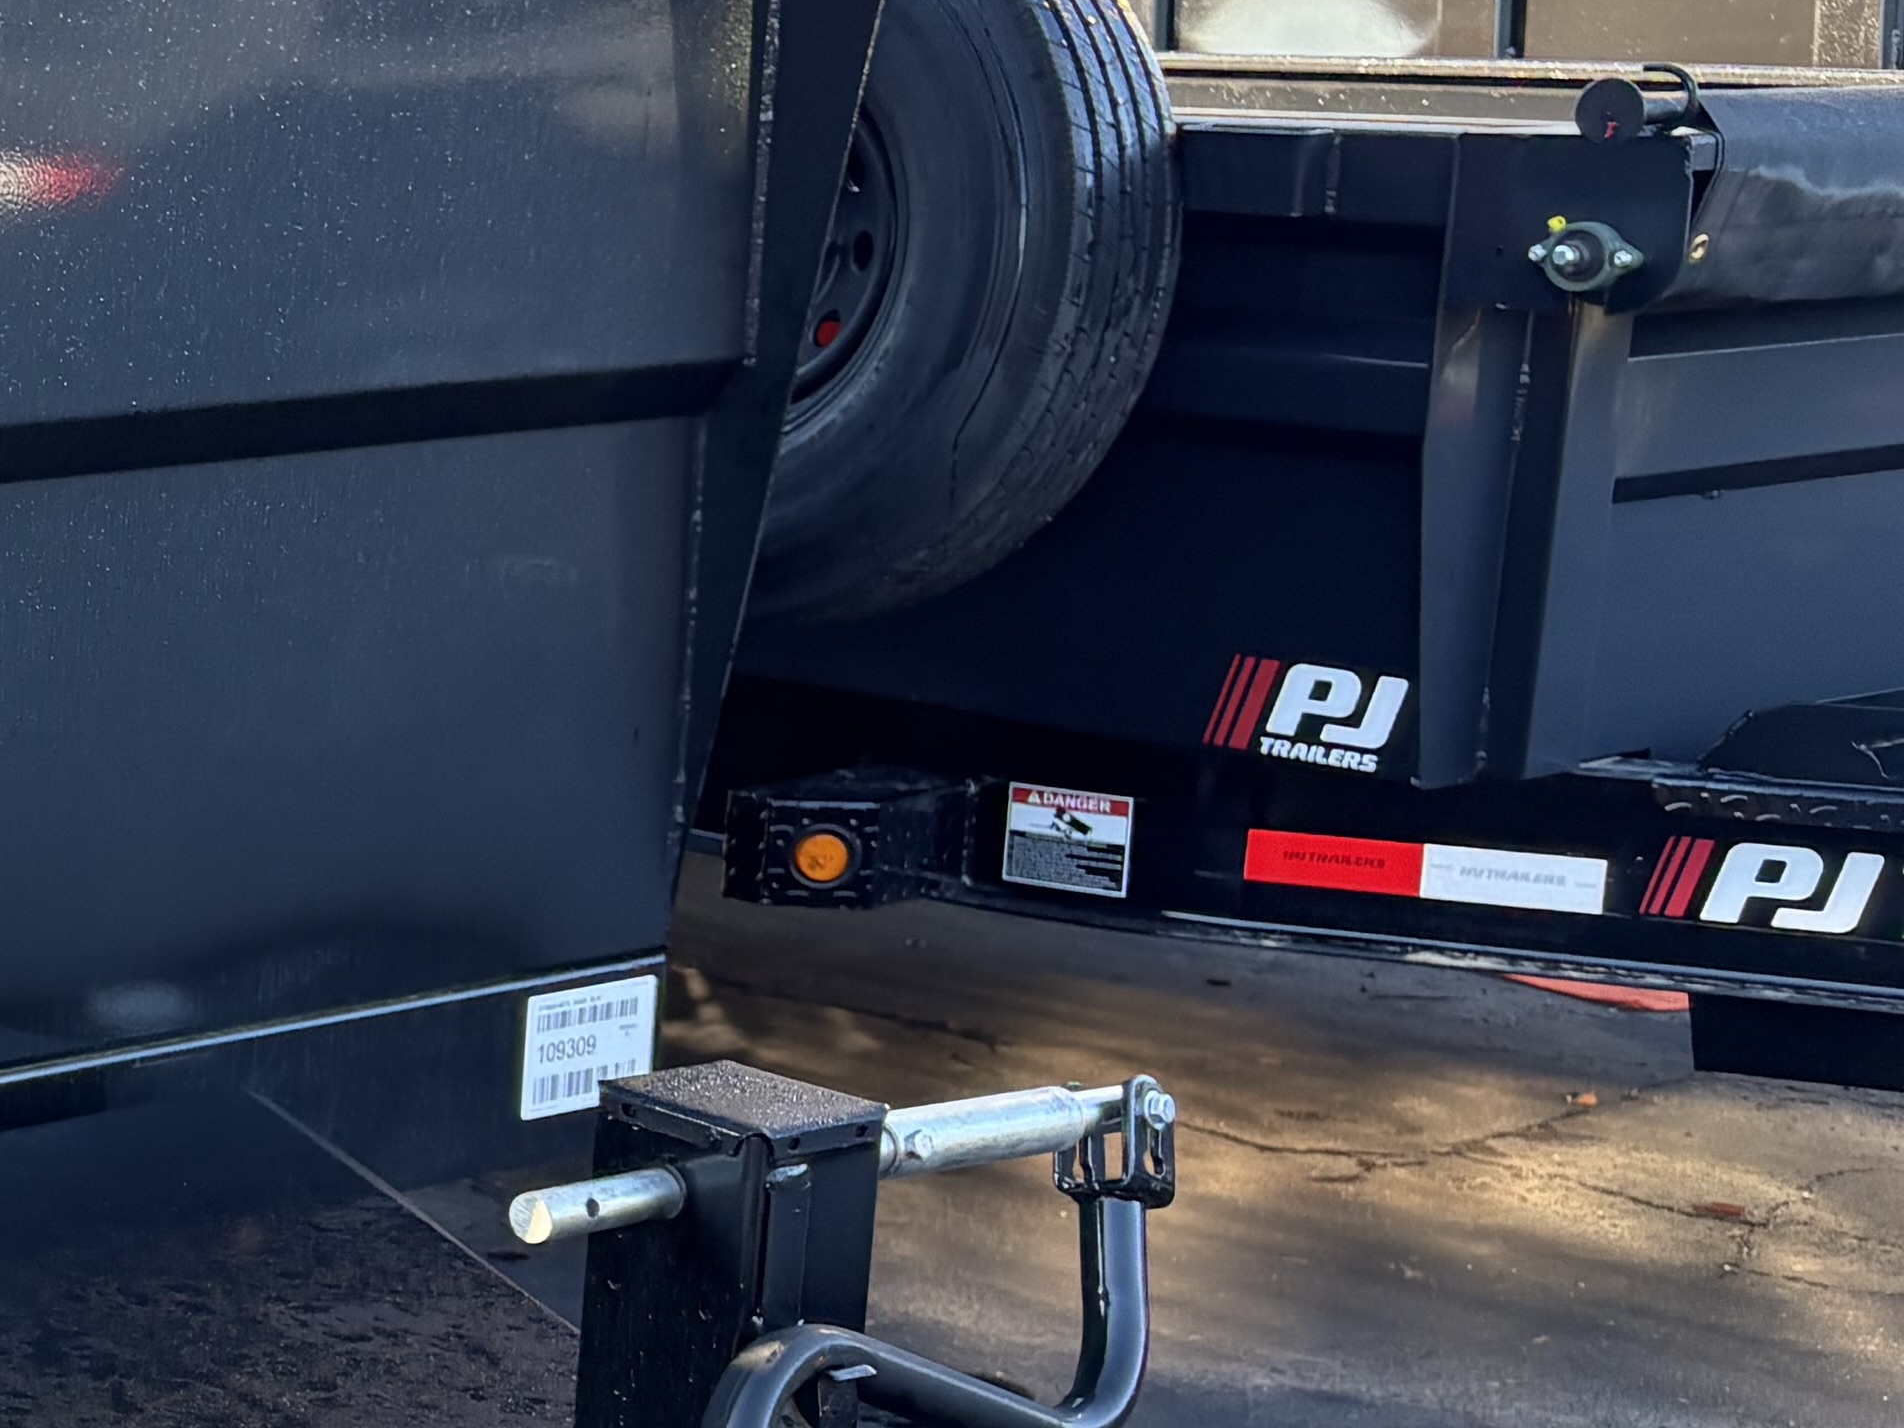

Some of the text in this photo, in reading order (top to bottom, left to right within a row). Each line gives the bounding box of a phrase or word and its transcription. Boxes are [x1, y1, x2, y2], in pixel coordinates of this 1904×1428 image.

[1265, 663, 1409, 750] PJ
[1259, 736, 1379, 773] TRAILERS
[1043, 791, 1111, 813] DANGER
[1699, 842, 1886, 934] PJ
[537, 1034, 598, 1065] 109309
